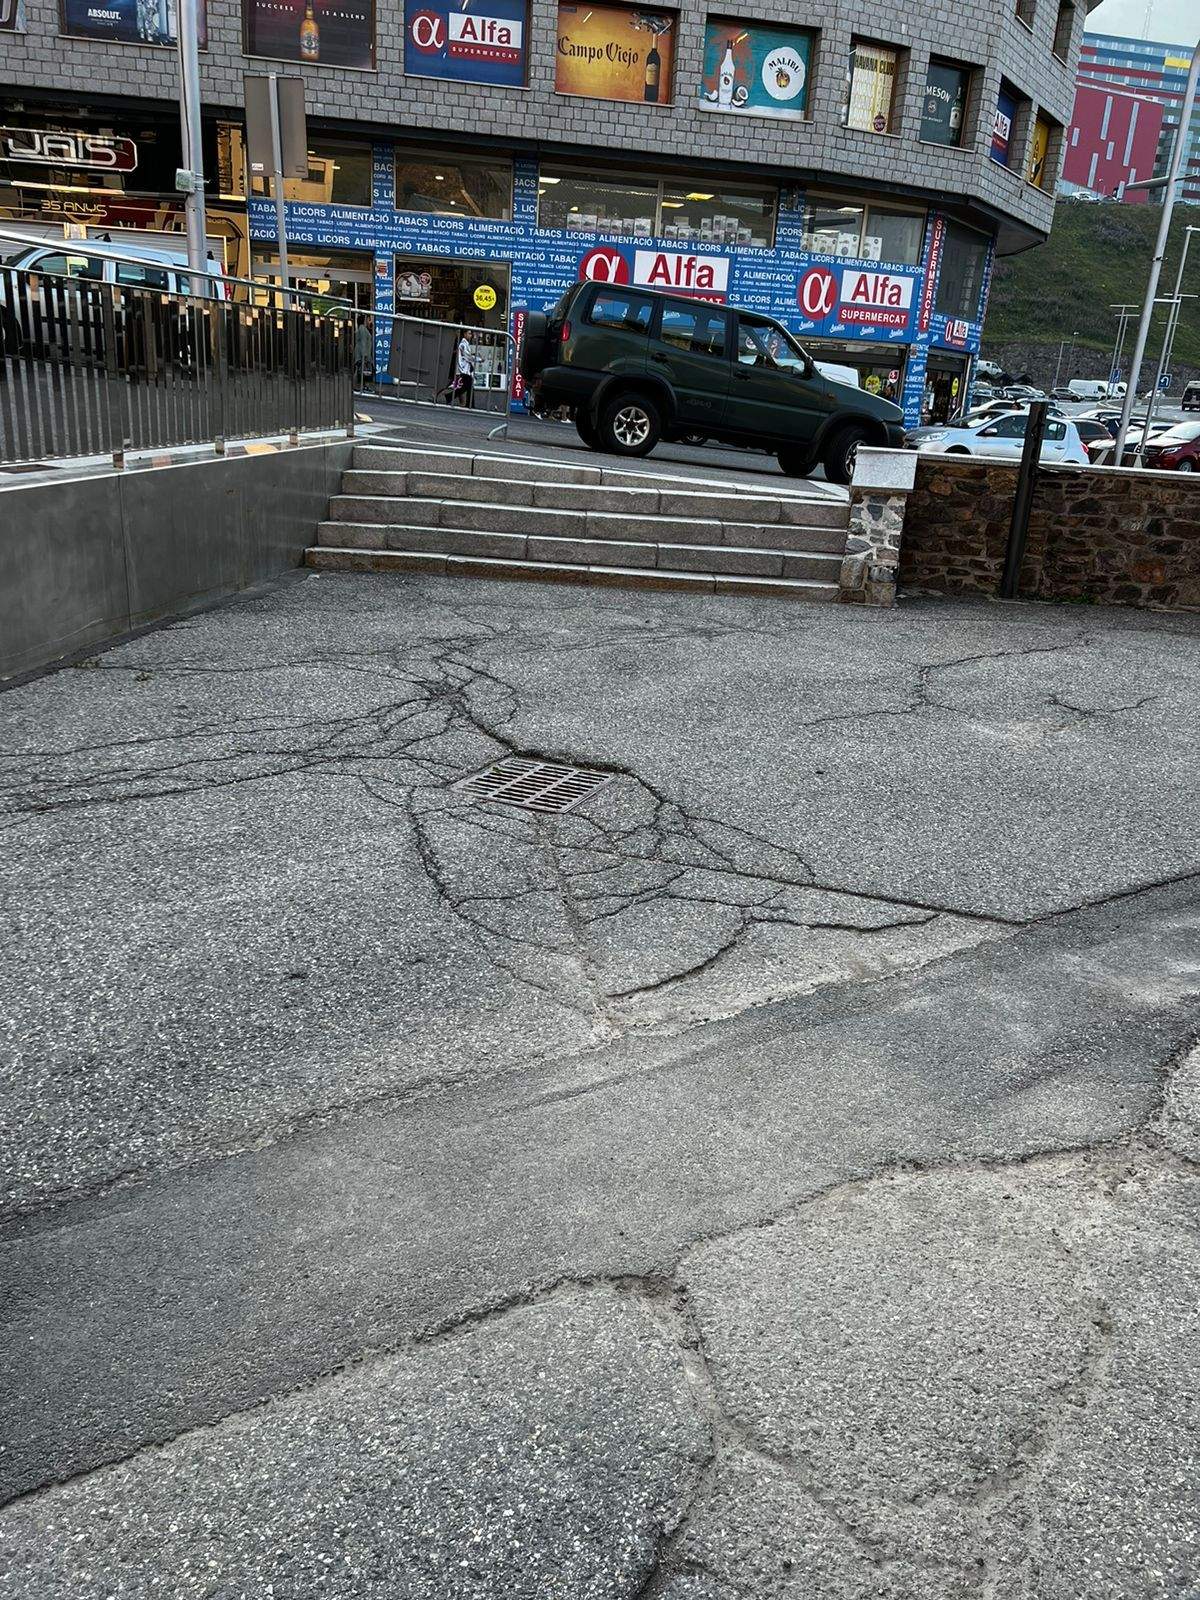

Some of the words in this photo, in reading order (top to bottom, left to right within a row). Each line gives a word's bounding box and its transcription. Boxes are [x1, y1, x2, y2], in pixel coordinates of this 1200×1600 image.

[460, 16, 511, 46] Alfa
[452, 46, 518, 60] SUPERMERCAT
[558, 36, 603, 63] Campo
[606, 43, 639, 69] Viejo
[768, 57, 801, 74] MALIBU
[41, 200, 61, 210] 35
[252, 203, 288, 214] TABAS
[293, 206, 326, 217] LICORS
[331, 209, 389, 224] ALIMENTACIÓ
[393, 215, 428, 227] TABACS
[433, 220, 463, 232] LICORS
[468, 222, 524, 236] ALIMENTACIÓ
[529, 228, 562, 239] TABACS
[566, 232, 596, 243] LICORS
[600, 234, 653, 247] ALIMENTACIÓ
[657, 239, 688, 250] TABACS
[692, 243, 721, 254] LICORS
[724, 246, 776, 258] ALIMENTACIÓ
[780, 250, 809, 261] TABACS
[811, 254, 835, 264] LICORS
[880, 262, 904, 273] TABACS
[318, 234, 350, 245] LICORS
[355, 238, 412, 251] ALIMENTACIÓ
[416, 243, 450, 255] TABACS
[454, 247, 486, 257] LICORS
[490, 250, 546, 263] ALIMENTACIÓ
[549, 254, 577, 264] TABAC
[647, 254, 714, 289] Alfa
[743, 270, 794, 283] ALIMENTACIÓ
[922, 220, 943, 329] SUPERMERCAT
[728, 293, 741, 302] CS
[743, 295, 771, 305] LICORS
[851, 273, 902, 307] Alfa
[841, 309, 906, 325] SUPERMERCAT
